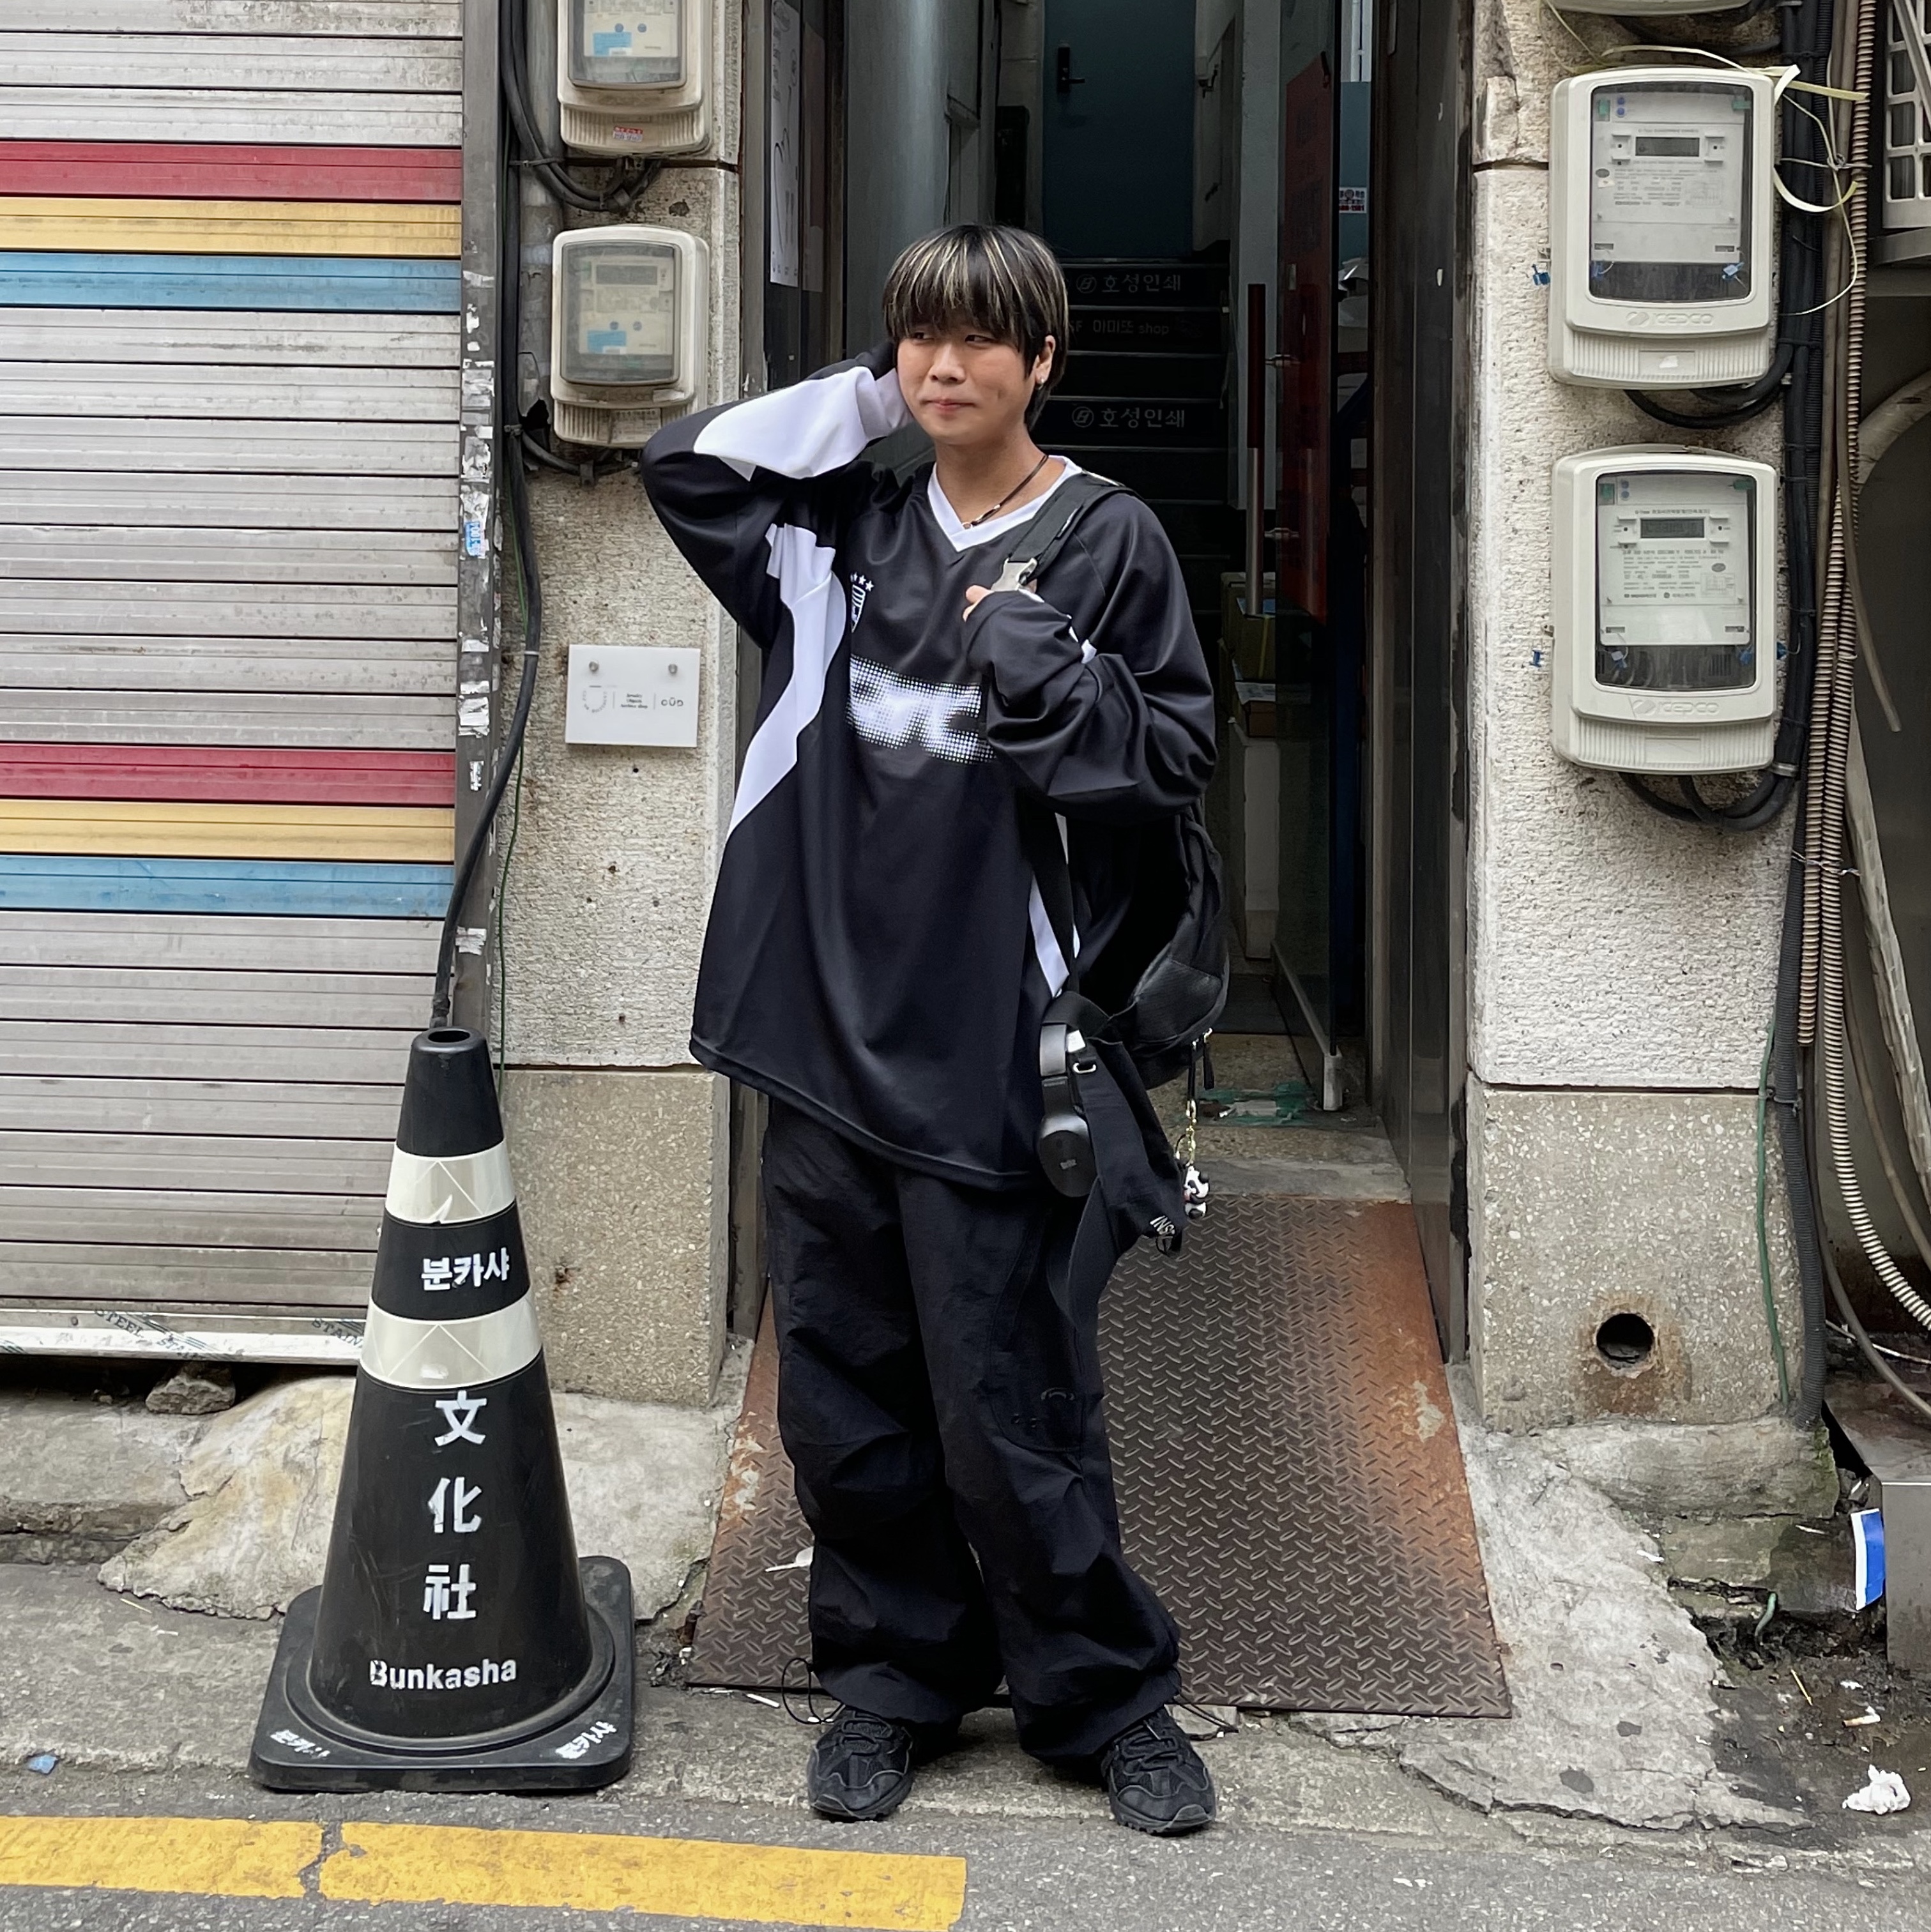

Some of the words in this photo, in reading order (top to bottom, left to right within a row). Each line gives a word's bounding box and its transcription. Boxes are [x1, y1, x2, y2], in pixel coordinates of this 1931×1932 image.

[1102, 273, 1181, 293] 호성인쇄
[1138, 322, 1170, 336] shop
[1098, 407, 1185, 429] 호성인쇄
[421, 1247, 510, 1291] 분카샤
[370, 1658, 517, 1690] Bunkasha
